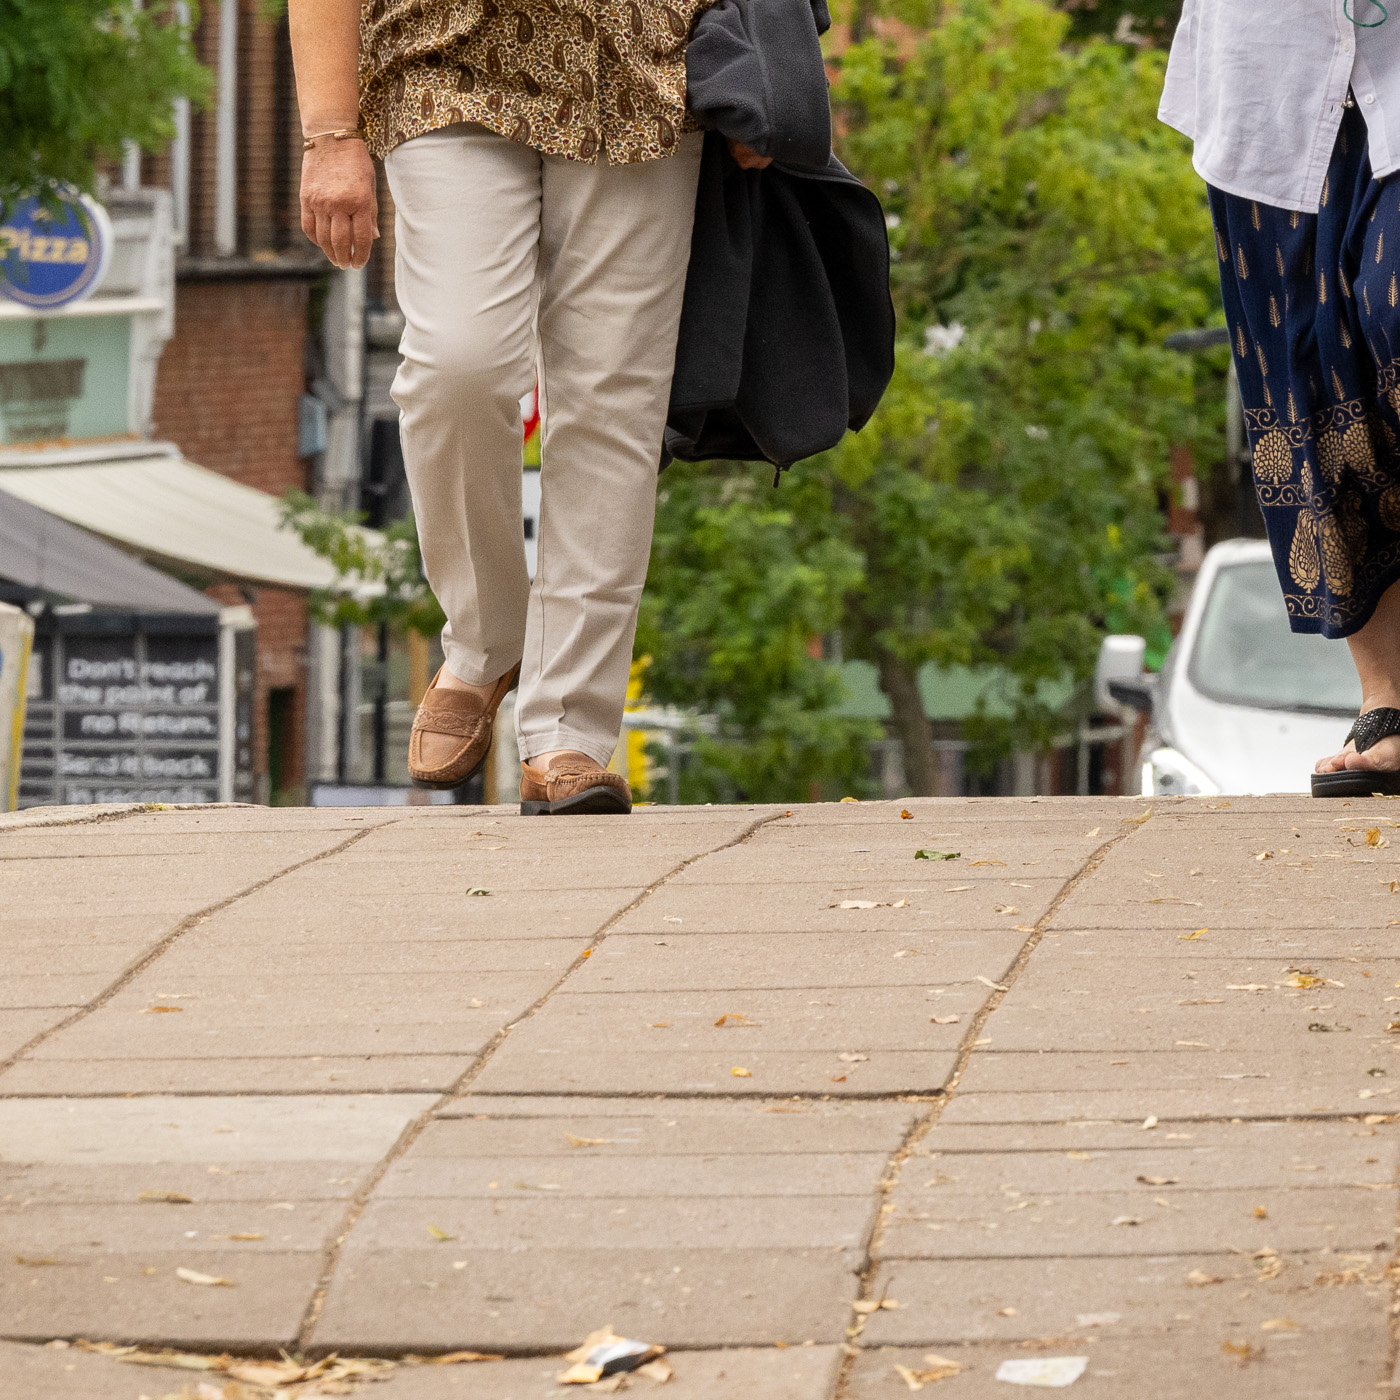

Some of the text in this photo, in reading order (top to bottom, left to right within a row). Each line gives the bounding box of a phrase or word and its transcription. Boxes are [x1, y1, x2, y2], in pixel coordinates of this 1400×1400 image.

[68, 658, 215, 680] Don't reach
[57, 683, 208, 707] the point of
[81, 714, 116, 734] no
